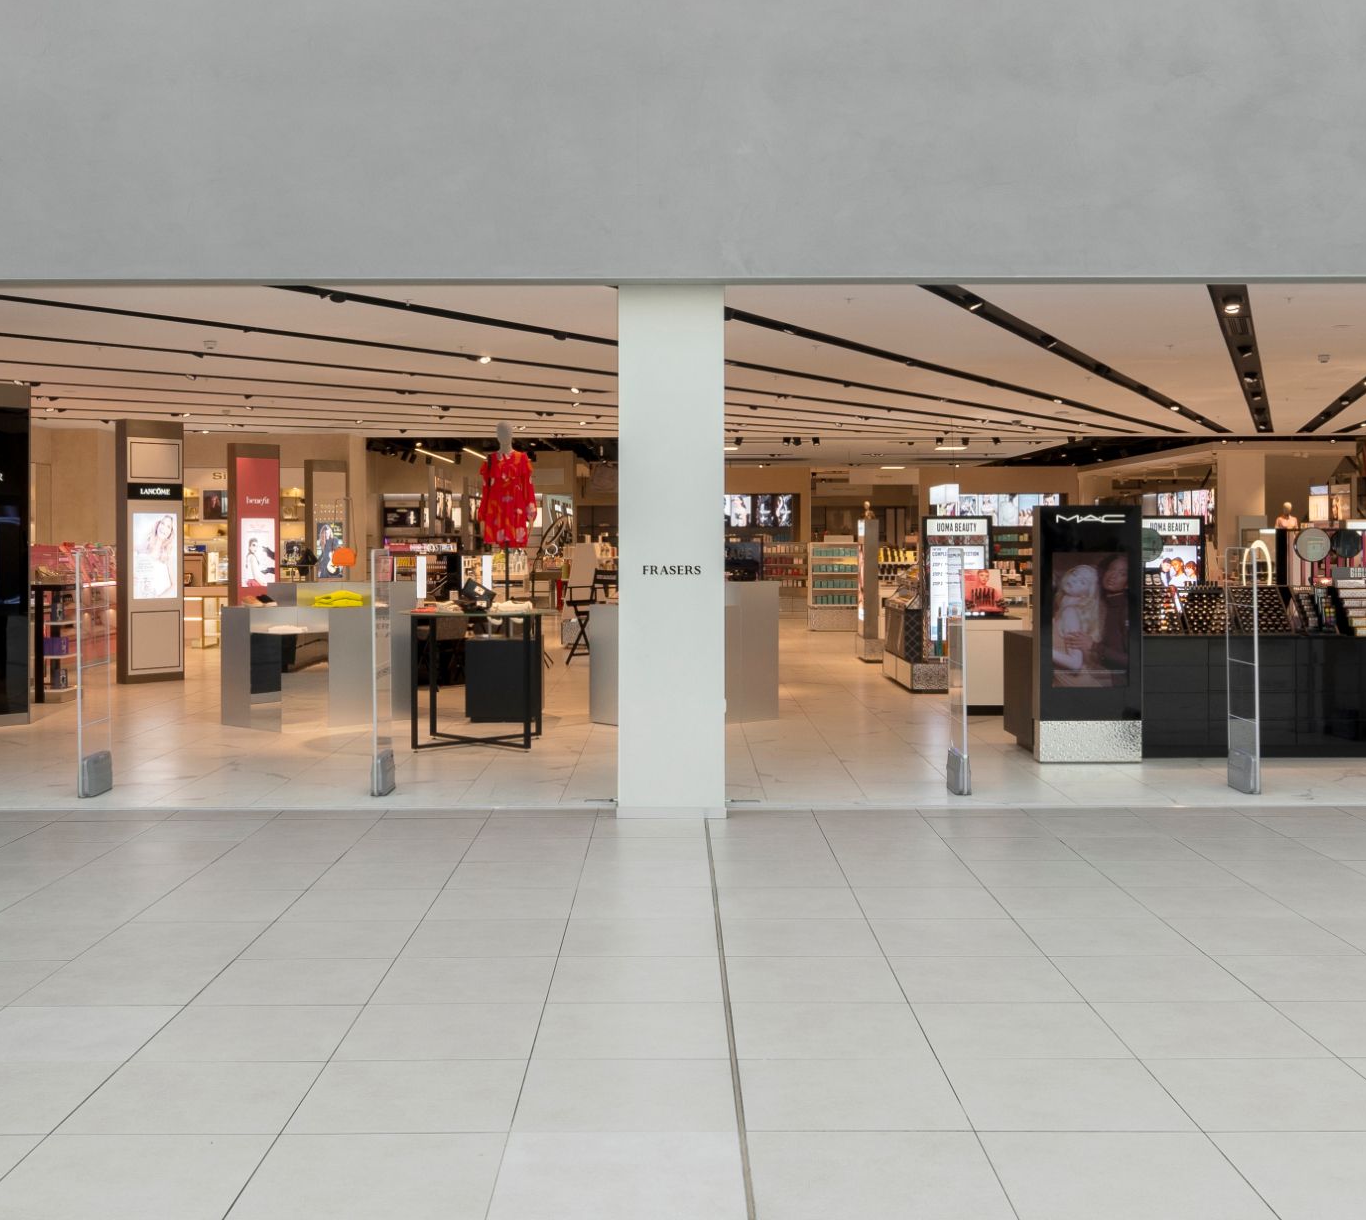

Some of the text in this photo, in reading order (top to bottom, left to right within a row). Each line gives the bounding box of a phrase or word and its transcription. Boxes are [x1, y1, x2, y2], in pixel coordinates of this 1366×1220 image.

[140, 487, 171, 496] LANCÔME
[245, 495, 271, 506] benefit
[936, 523, 977, 532] UOMA BEAUTY
[1167, 522, 1190, 532] BEAUTY
[642, 564, 702, 576] FRASERS
